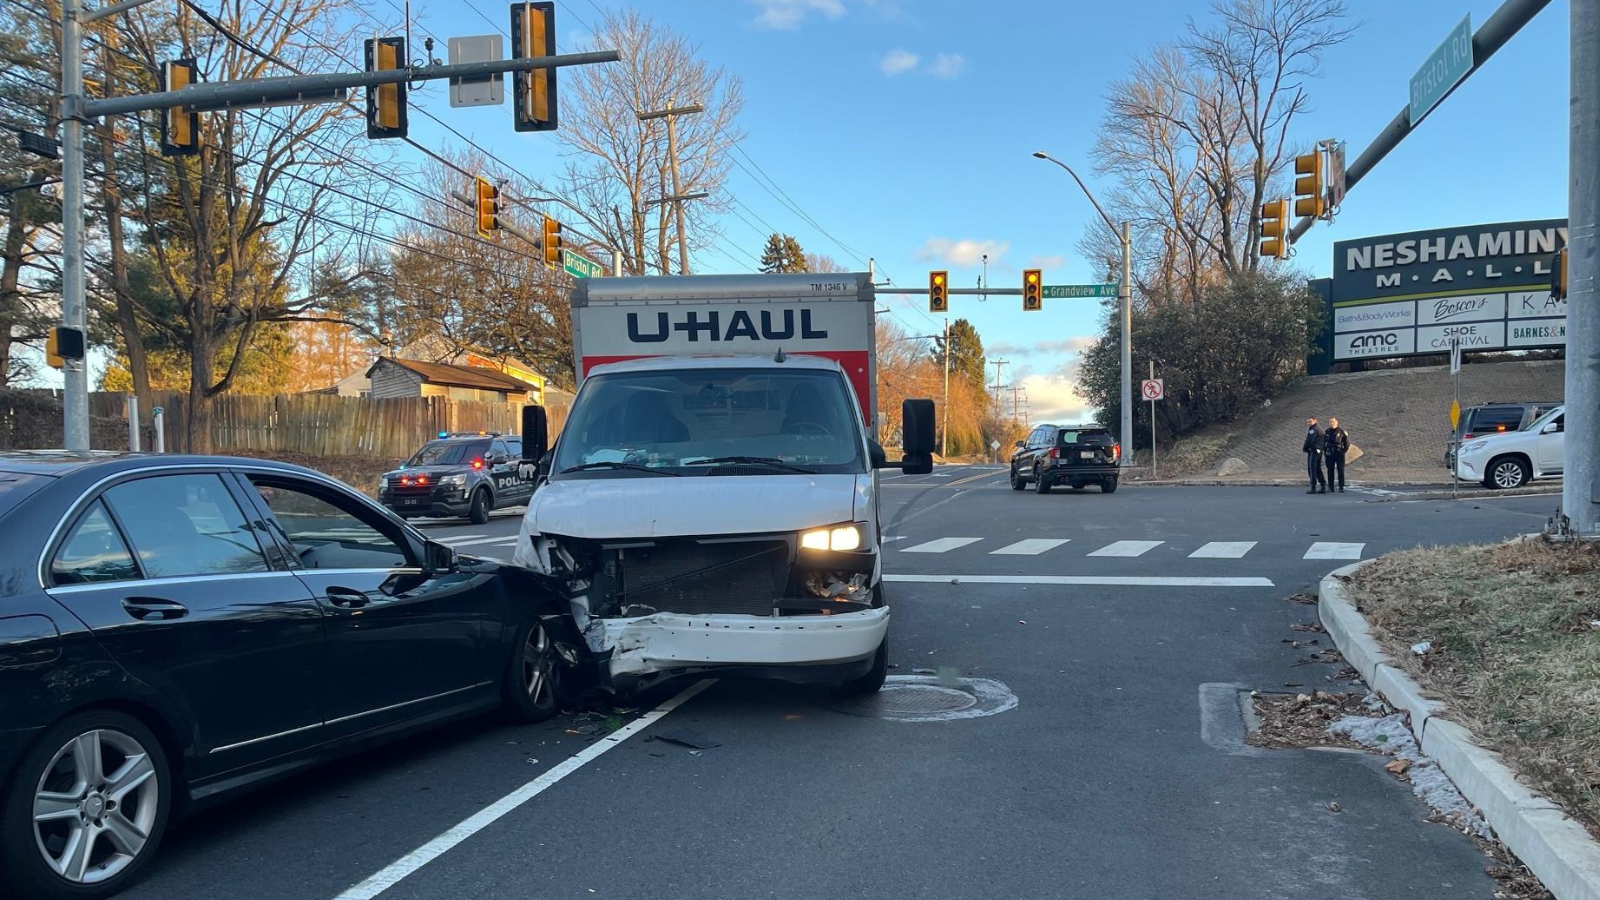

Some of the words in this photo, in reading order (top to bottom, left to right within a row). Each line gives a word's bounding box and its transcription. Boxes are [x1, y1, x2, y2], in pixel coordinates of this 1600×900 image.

[1413, 47, 1448, 108] Bristol
[1453, 25, 1468, 67] Rd
[566, 253, 590, 277] Bristol
[592, 266, 600, 277] Rd
[810, 283, 822, 291] TM
[825, 283, 841, 291] 1346
[842, 282, 848, 291] V
[1050, 285, 1096, 297] Grandview
[1100, 285, 1116, 296] Ave
[1523, 294, 1557, 310] KA
[626, 308, 828, 343] U-HAUL
[1443, 326, 1477, 337] SHOE
[1513, 325, 1566, 339] BARNES&N
[1348, 346, 1399, 356] THEATRES
[498, 475, 533, 488] POLI
